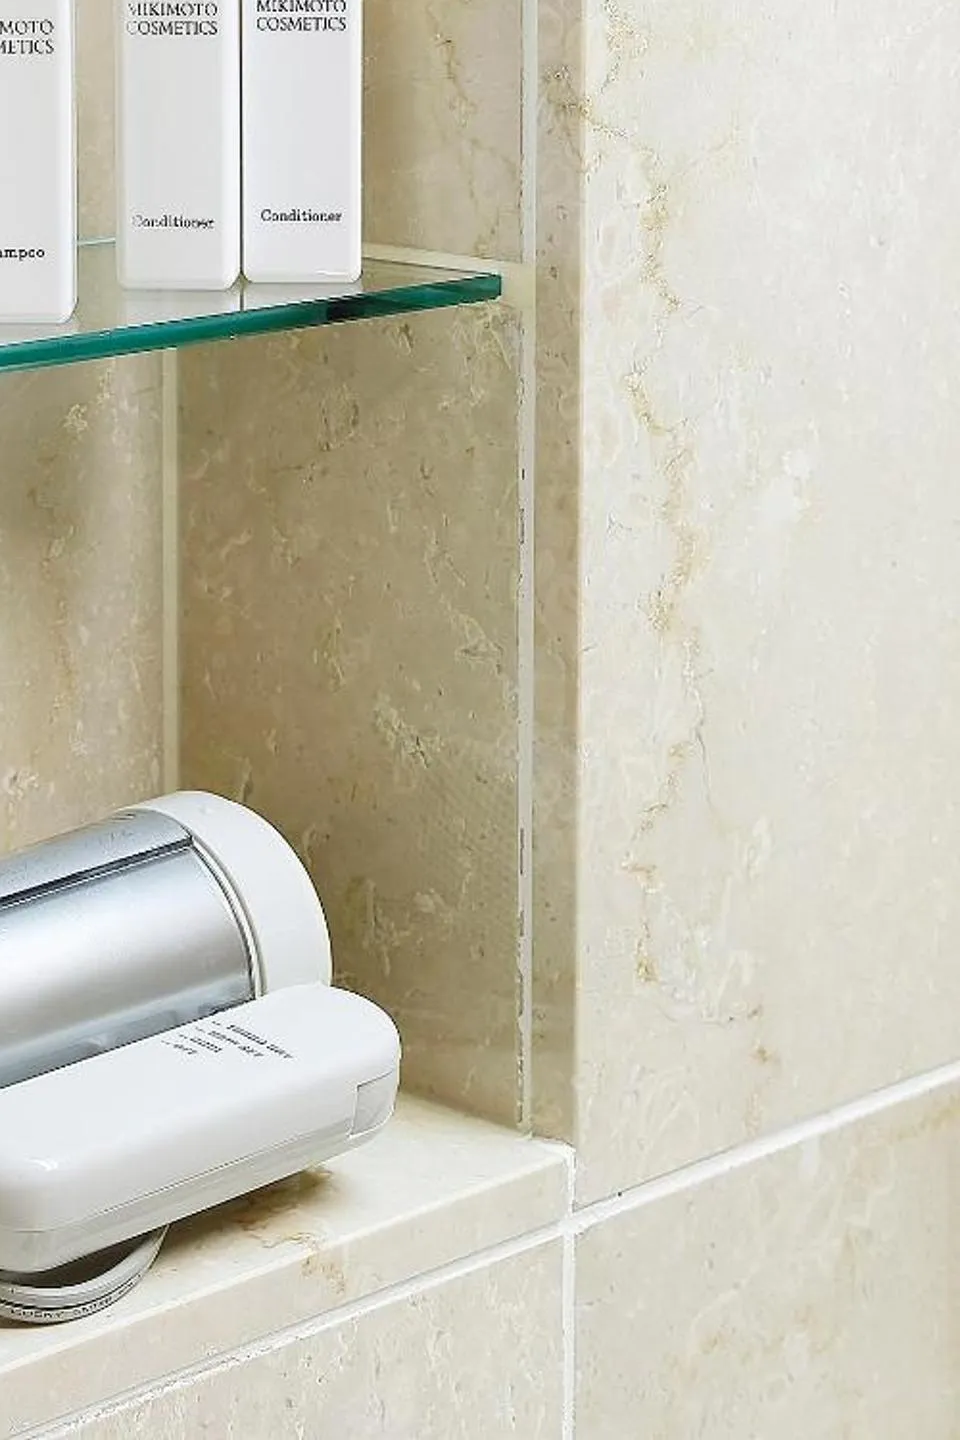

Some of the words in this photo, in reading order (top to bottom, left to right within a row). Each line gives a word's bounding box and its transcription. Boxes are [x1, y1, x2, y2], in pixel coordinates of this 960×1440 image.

[128, 3, 218, 17] MIKIMOTO
[126, 20, 218, 36] COSMETICS
[256, 17, 347, 32] COSMETICS
[260, 209, 341, 222] Conditioner
